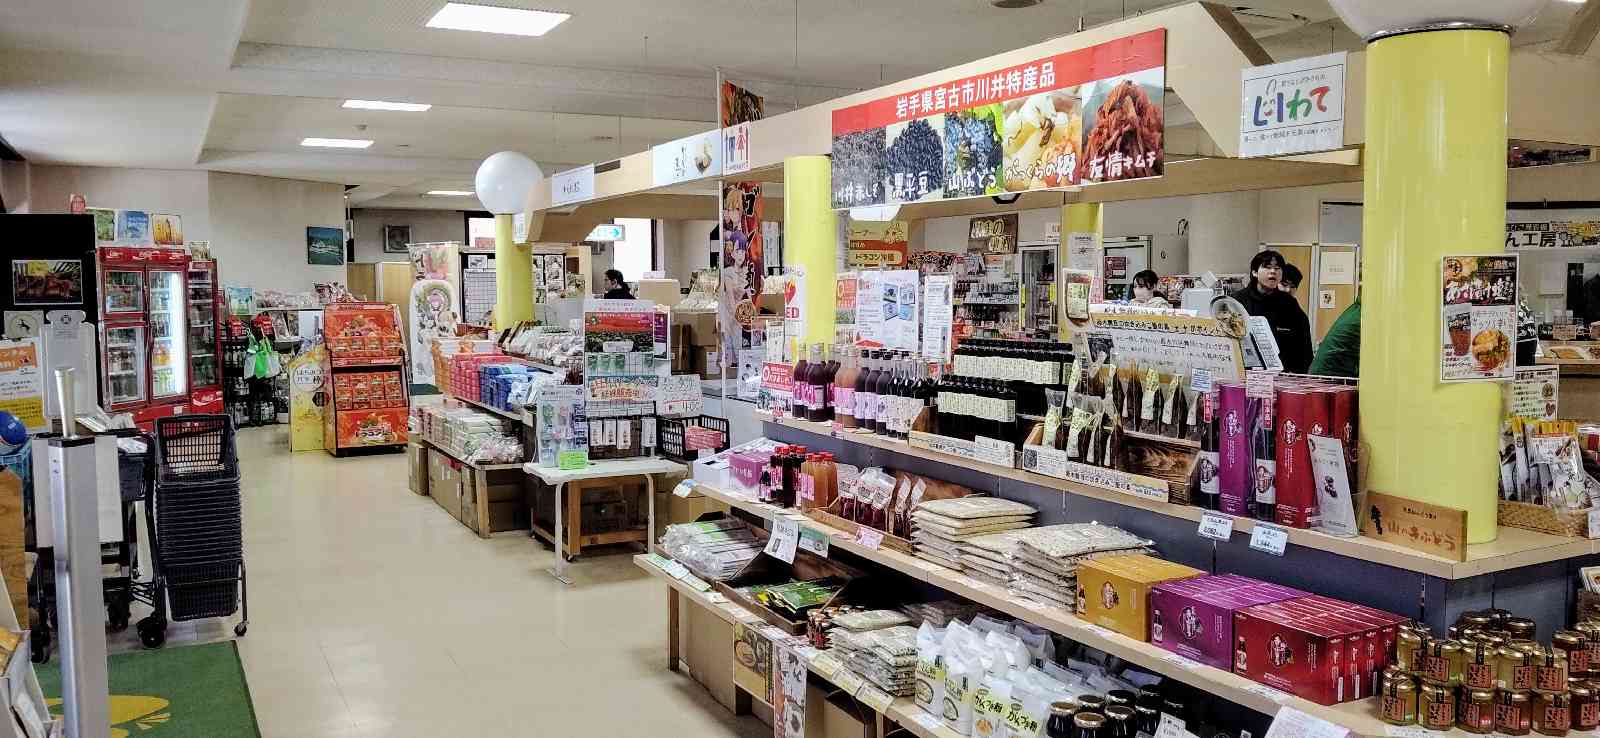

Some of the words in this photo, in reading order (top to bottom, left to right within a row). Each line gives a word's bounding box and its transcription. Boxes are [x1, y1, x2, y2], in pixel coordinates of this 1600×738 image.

[896, 61, 1055, 117] 岩手県宮古市川井特産品
[1089, 151, 1157, 178] 友情キムチ
[892, 170, 928, 198] 黒平豆
